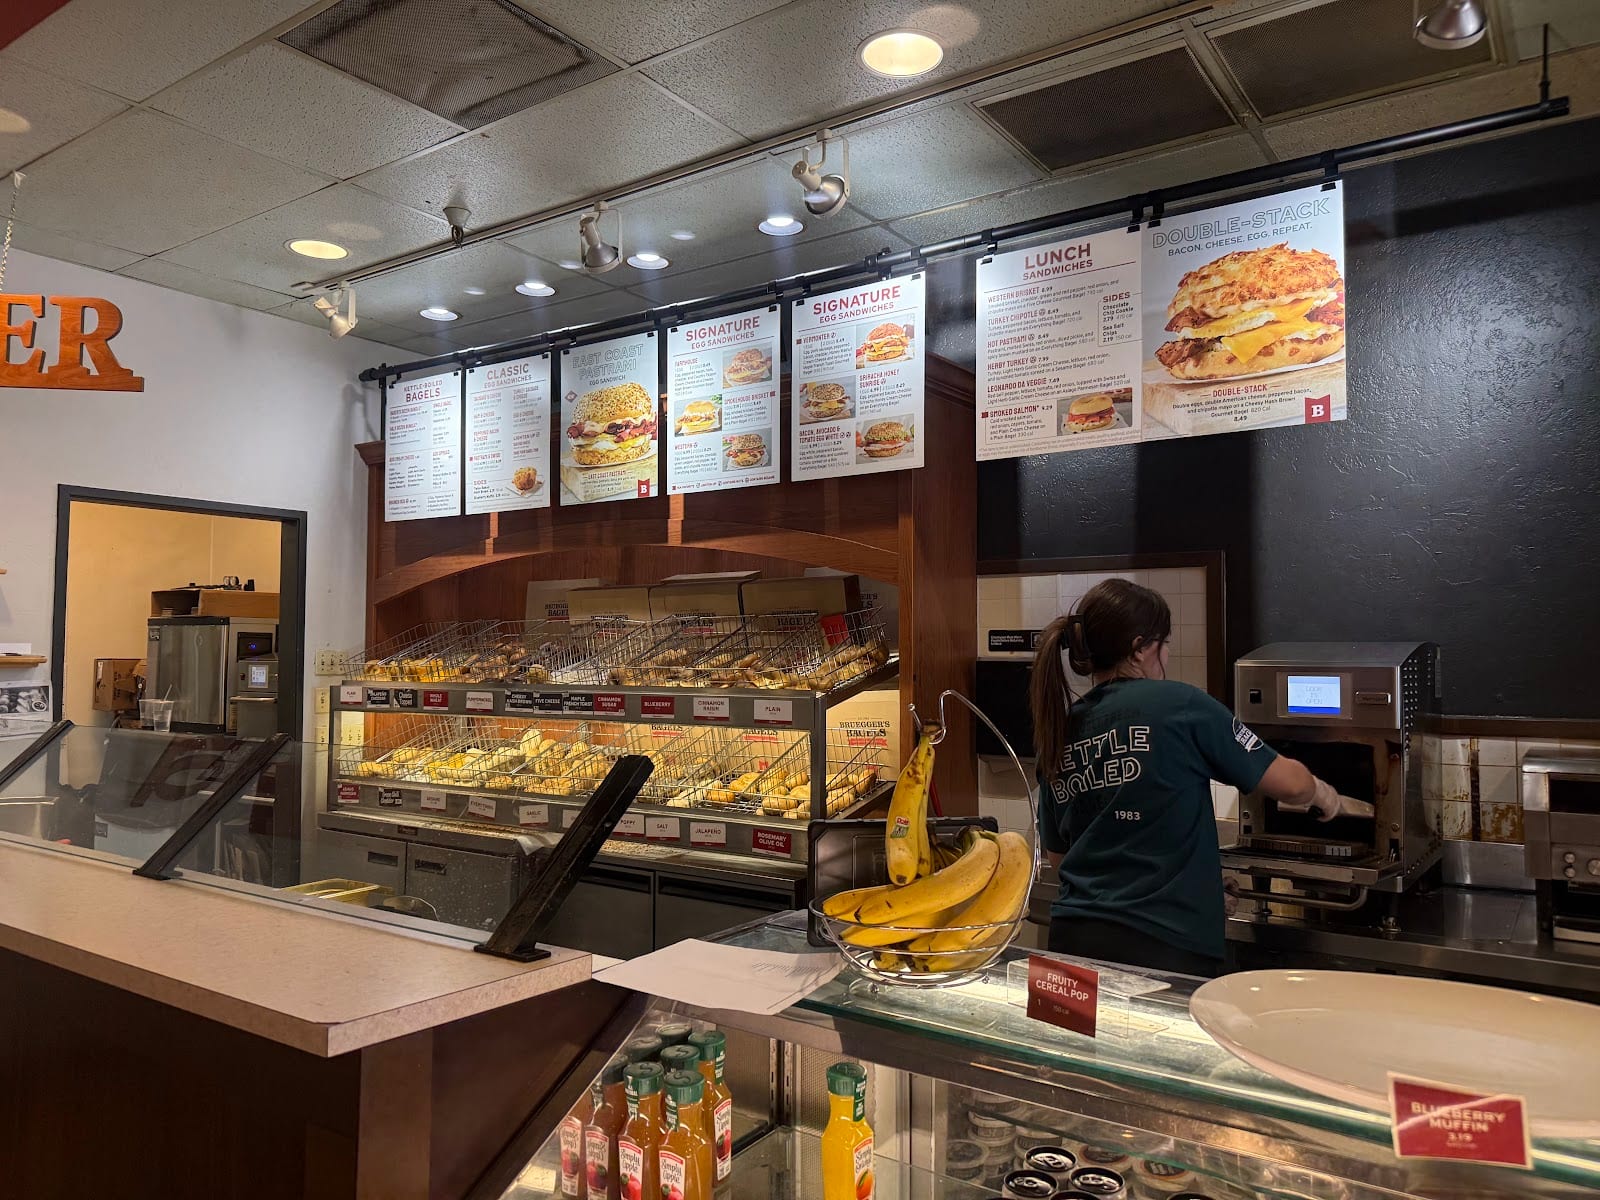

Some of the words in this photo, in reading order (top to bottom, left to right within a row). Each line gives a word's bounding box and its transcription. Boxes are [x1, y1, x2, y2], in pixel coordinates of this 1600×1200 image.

[1152, 197, 1331, 249] DOUBLE-STACK
[1168, 243, 1203, 257] BACON.
[1205, 235, 1245, 249] CHEESE.
[1247, 230, 1271, 242] EGG.
[1273, 221, 1313, 236] REPEAT.
[1025, 242, 1091, 270] LUNCH
[1023, 259, 1093, 281] SANDWICHES
[813, 285, 901, 315] SIGNATURE
[988, 292, 1015, 304] WESTERN
[1015, 286, 1040, 298] BRISKET
[1102, 291, 1131, 303] SIDES
[819, 314, 837, 324] EGG
[838, 301, 895, 319] SANDWICHES
[1102, 302, 1130, 311] Chocolate
[1102, 310, 1115, 318] Chip
[1115, 306, 1134, 314] Cookie
[989, 316, 1010, 326] TURKEY
[1010, 310, 1038, 322] CHIPOTLE
[686, 316, 760, 342] SIGNATURE
[691, 341, 706, 350] EGG
[707, 330, 755, 347] SANDWICHES
[803, 332, 830, 344] VERMONTER
[988, 340, 998, 348] HOT
[1000, 335, 1027, 346] PASTRAMI
[572, 351, 601, 369] EAST
[604, 343, 644, 361] COAST
[988, 361, 1006, 370] HERBY
[1006, 357, 1029, 367] TURKEY
[487, 363, 529, 380] CLASSIC
[579, 358, 637, 380] PASTRAMI
[883, 369, 900, 378] HONEY
[404, 379, 443, 392] KETTLE-BOILED
[484, 380, 496, 389] EGG
[496, 374, 532, 387] SANDWICHES
[859, 379, 880, 389] SUNRISE
[987, 381, 1017, 393] LEONARDO
[1017, 381, 1026, 389] DA
[1026, 377, 1047, 387] VEGGIE
[405, 387, 441, 403] BAGELS
[751, 391, 769, 401] BRISKET
[1212, 383, 1268, 398] DOUBLE-STACK
[1267, 389, 1293, 398] peppered
[1244, 400, 1264, 408] Cheesy
[1311, 404, 1325, 418] B
[990, 408, 1013, 418] SMOKED
[1210, 410, 1233, 418] Gourmet
[1233, 408, 1249, 416] Bagel
[640, 484, 648, 494] B
[839, 720, 891, 729] BRUEGGER'S
[846, 728, 887, 738] BAGELS
[1059, 725, 1150, 772] ETTLE
[1114, 810, 1141, 821] 1983
[757, 831, 787, 842] ROSEMARY
[758, 838, 775, 846] OLIVE
[775, 840, 785, 848] OIL
[1047, 972, 1079, 989] FRUITY
[1035, 979, 1070, 998] CEREAL
[1070, 989, 1089, 1002] POP
[1410, 1101, 1507, 1123] BLUEBERRY
[1428, 1118, 1490, 1133] MUFFIN
[1447, 1132, 1473, 1142] 3.19
[620, 1148, 641, 1168] Simply
[661, 1158, 682, 1179] Simply
